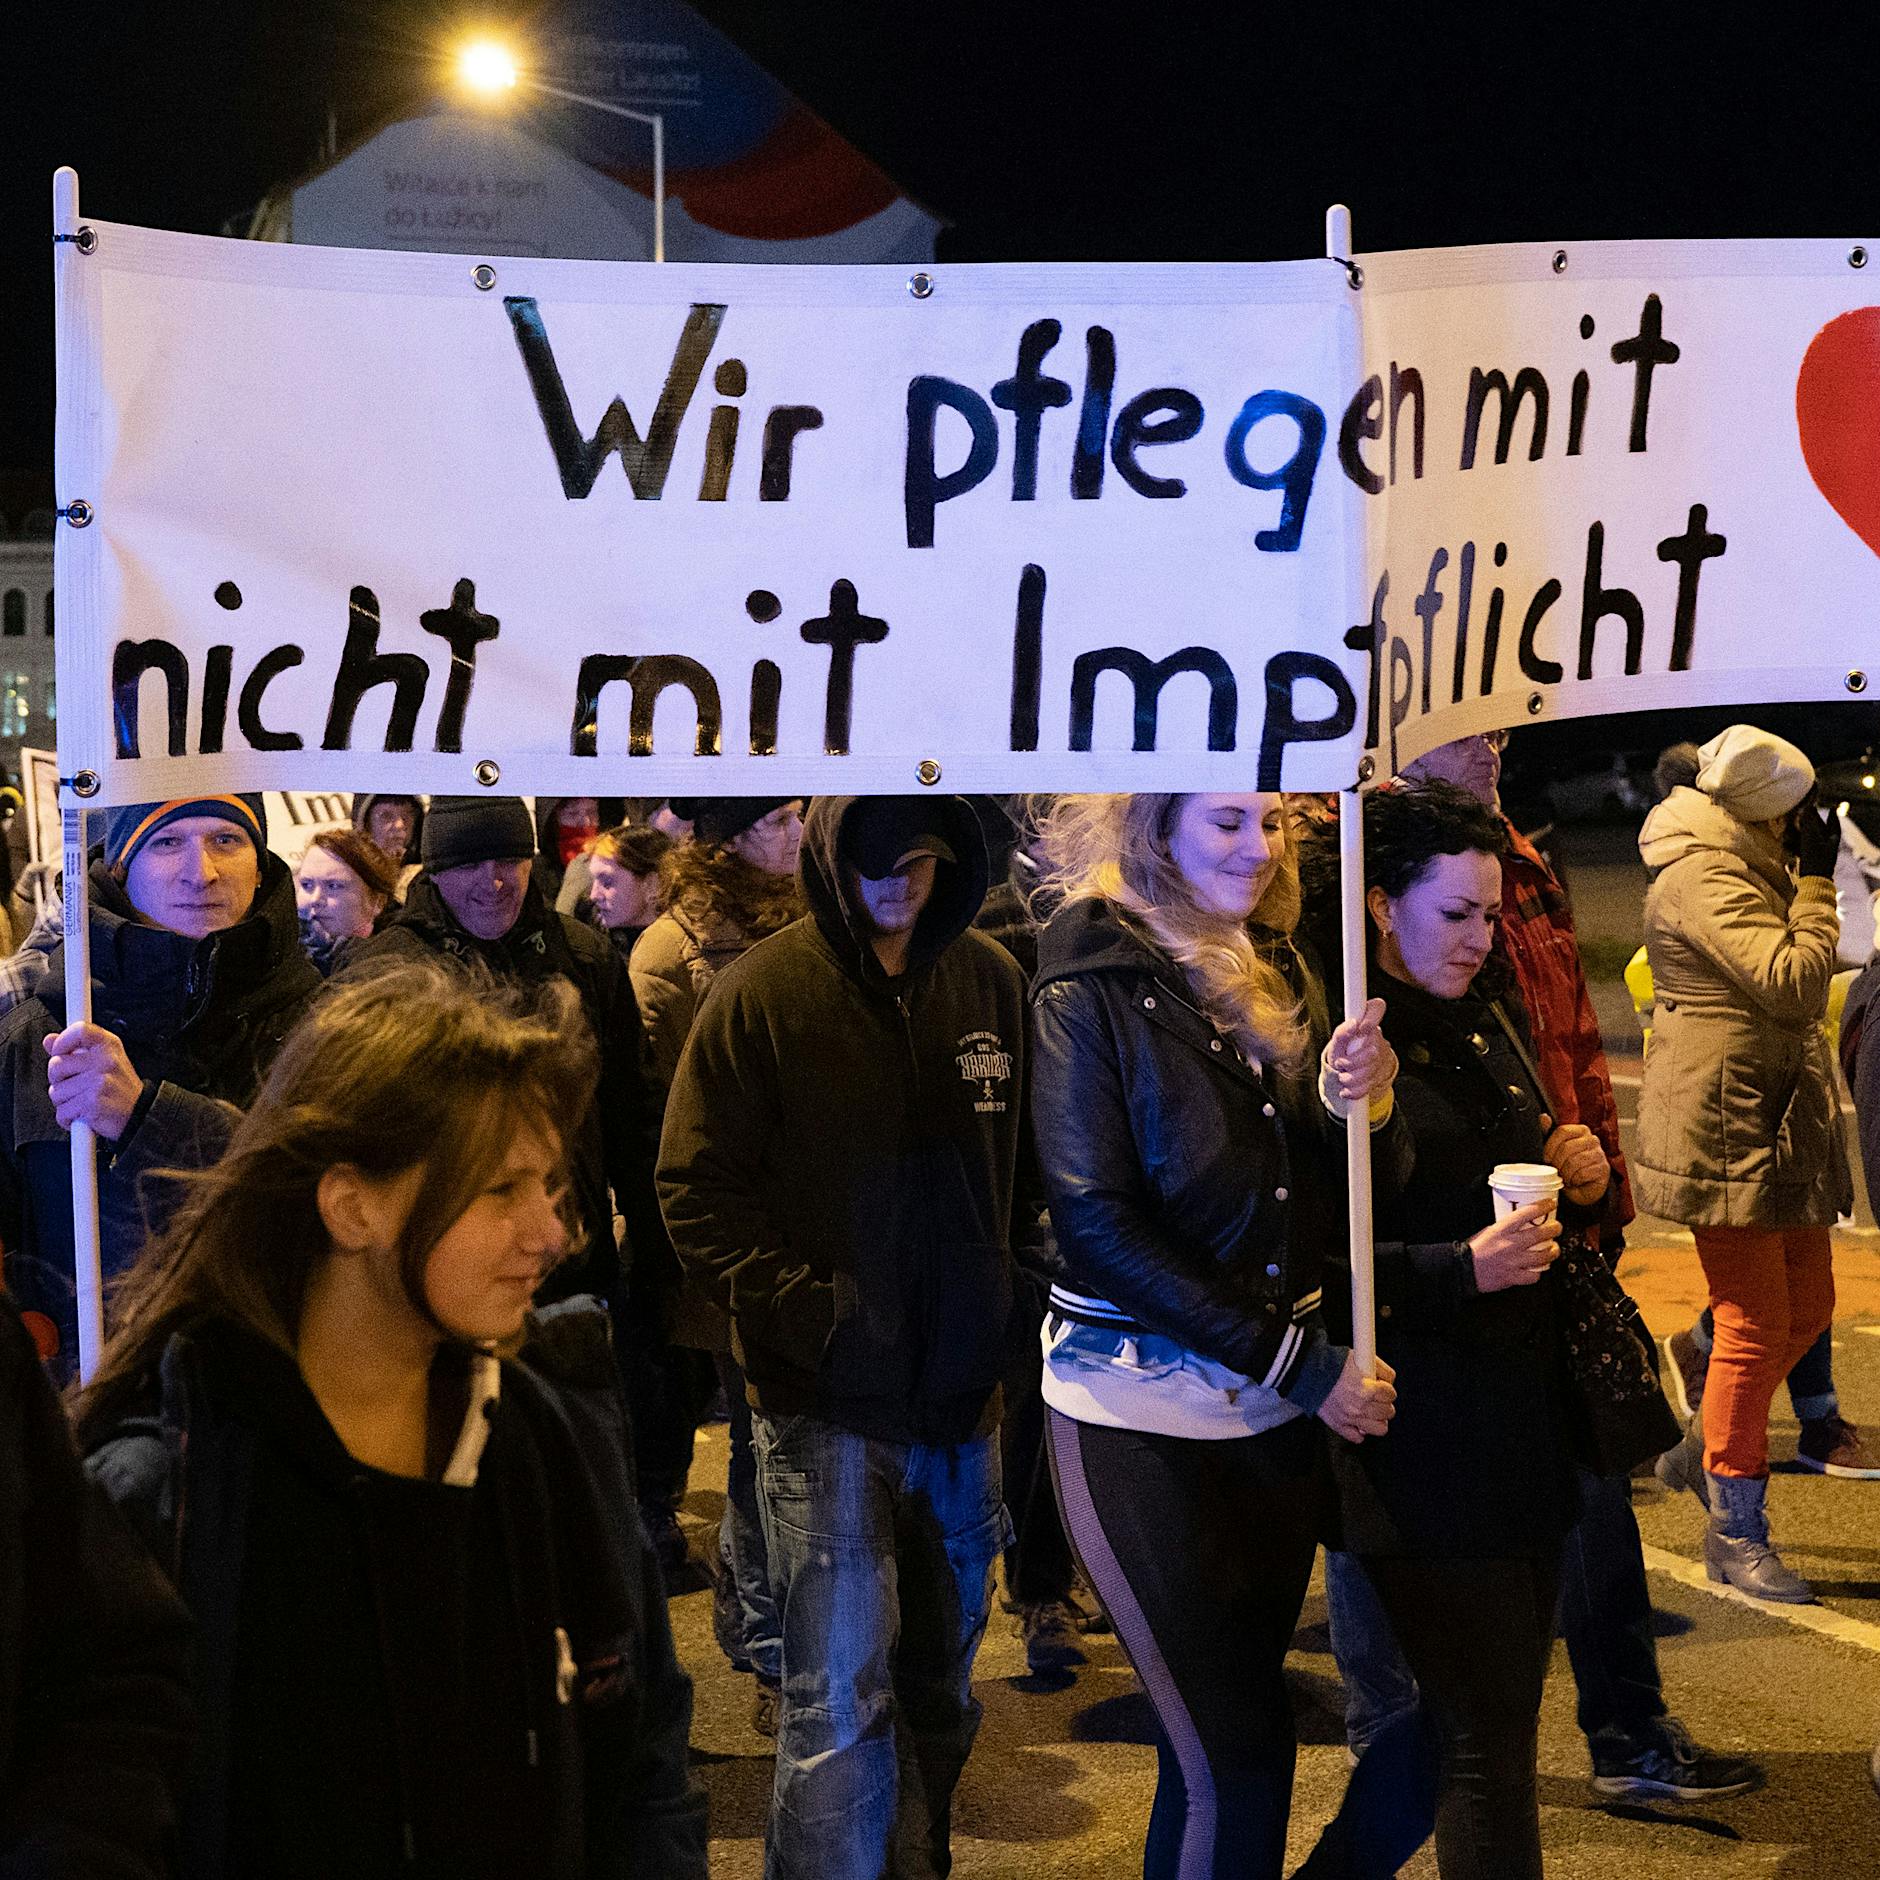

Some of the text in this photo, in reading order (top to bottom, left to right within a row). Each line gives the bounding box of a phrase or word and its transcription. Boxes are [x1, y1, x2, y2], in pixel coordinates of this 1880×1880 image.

[503, 294, 1681, 552] Wir pflegen mit
[112, 504, 1727, 791] nicht mit Impfpflicht
[957, 1051, 1012, 1081] YAKUZA
